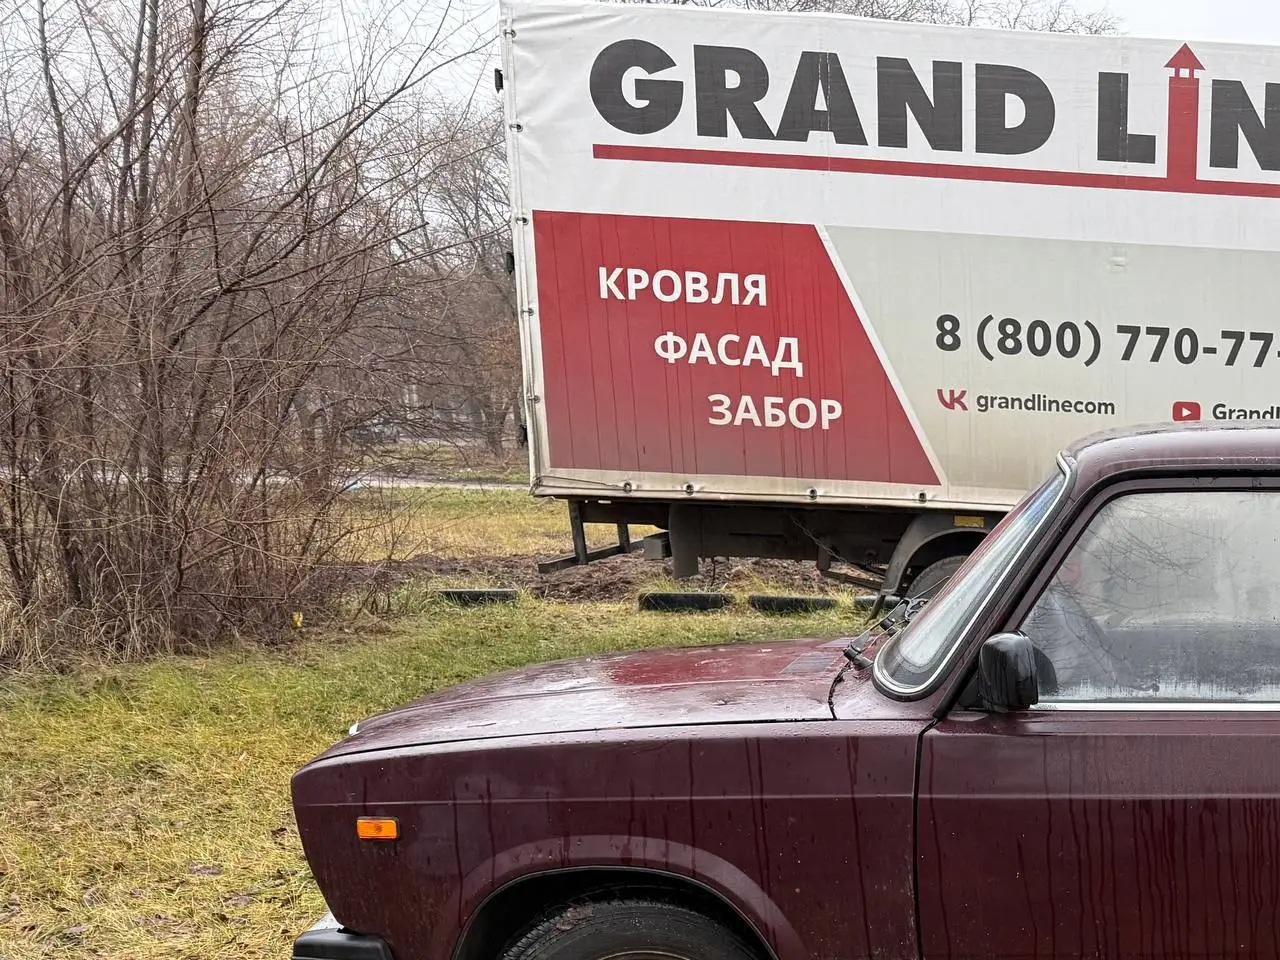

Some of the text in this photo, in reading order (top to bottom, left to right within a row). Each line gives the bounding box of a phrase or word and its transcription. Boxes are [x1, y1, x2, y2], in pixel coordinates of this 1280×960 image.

[589, 38, 1056, 155] GRAND
[598, 266, 768, 307] КРОВЛЯ
[654, 331, 804, 378] ФАСАД
[936, 314, 961, 351] 8
[977, 314, 1101, 367] (800)
[707, 393, 843, 431] ЗАБОР
[976, 393, 1116, 415] grandlinecom
